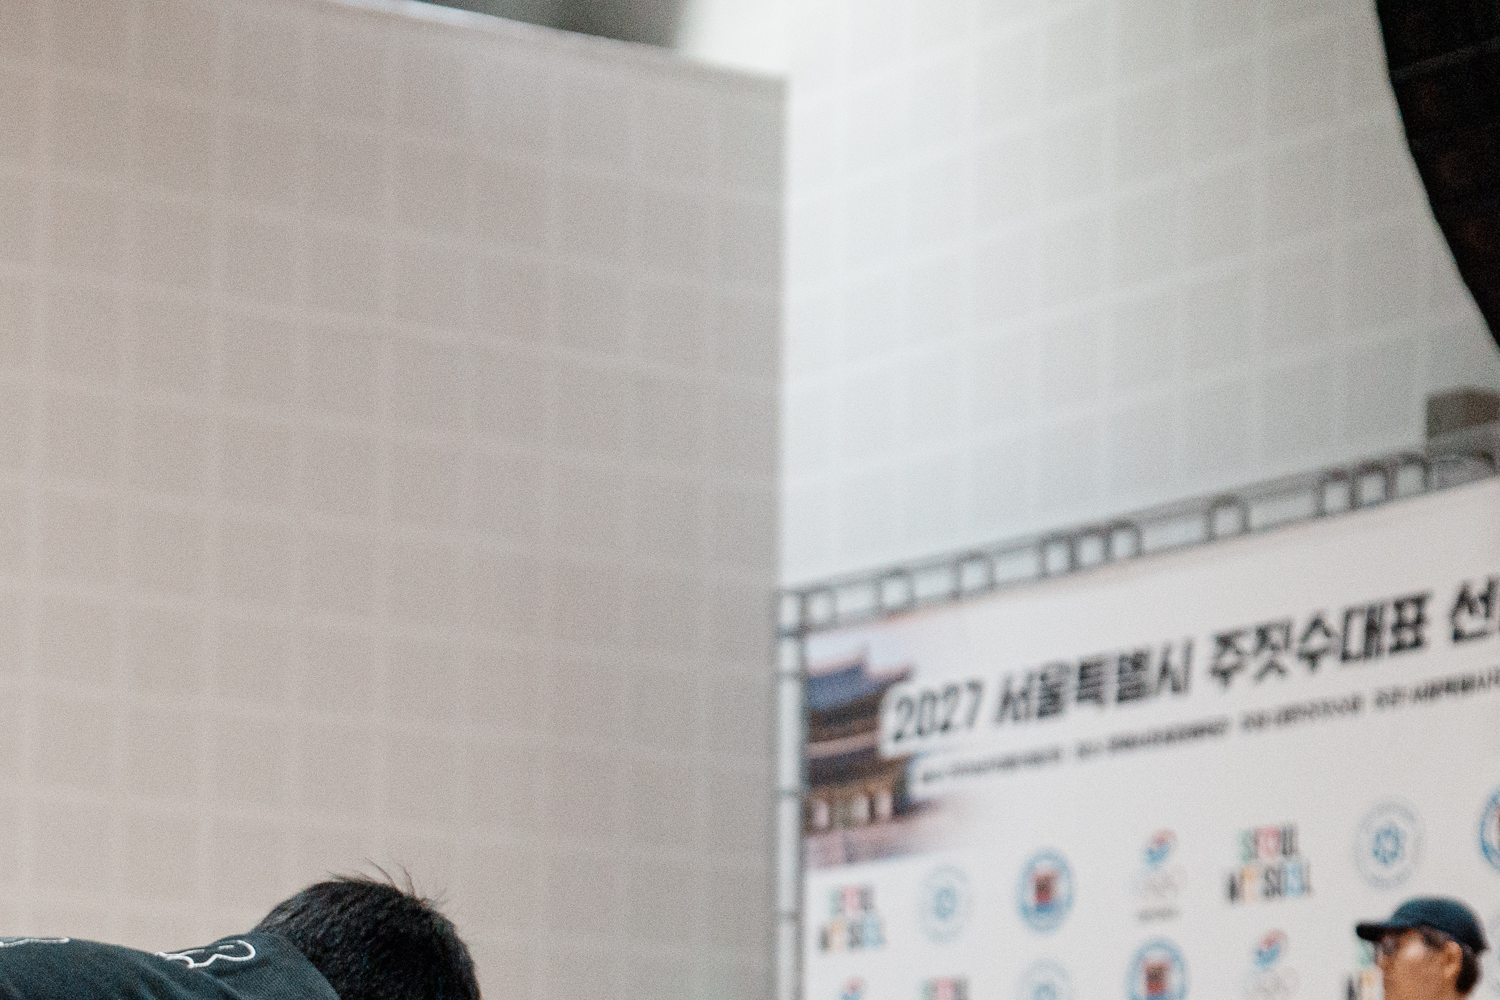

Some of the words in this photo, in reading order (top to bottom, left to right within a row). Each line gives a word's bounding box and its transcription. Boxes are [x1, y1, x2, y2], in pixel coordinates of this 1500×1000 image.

[892, 678, 981, 741] 2027
[995, 640, 1194, 728] 서울특별시
[1208, 592, 1433, 690] 주짓수대표
